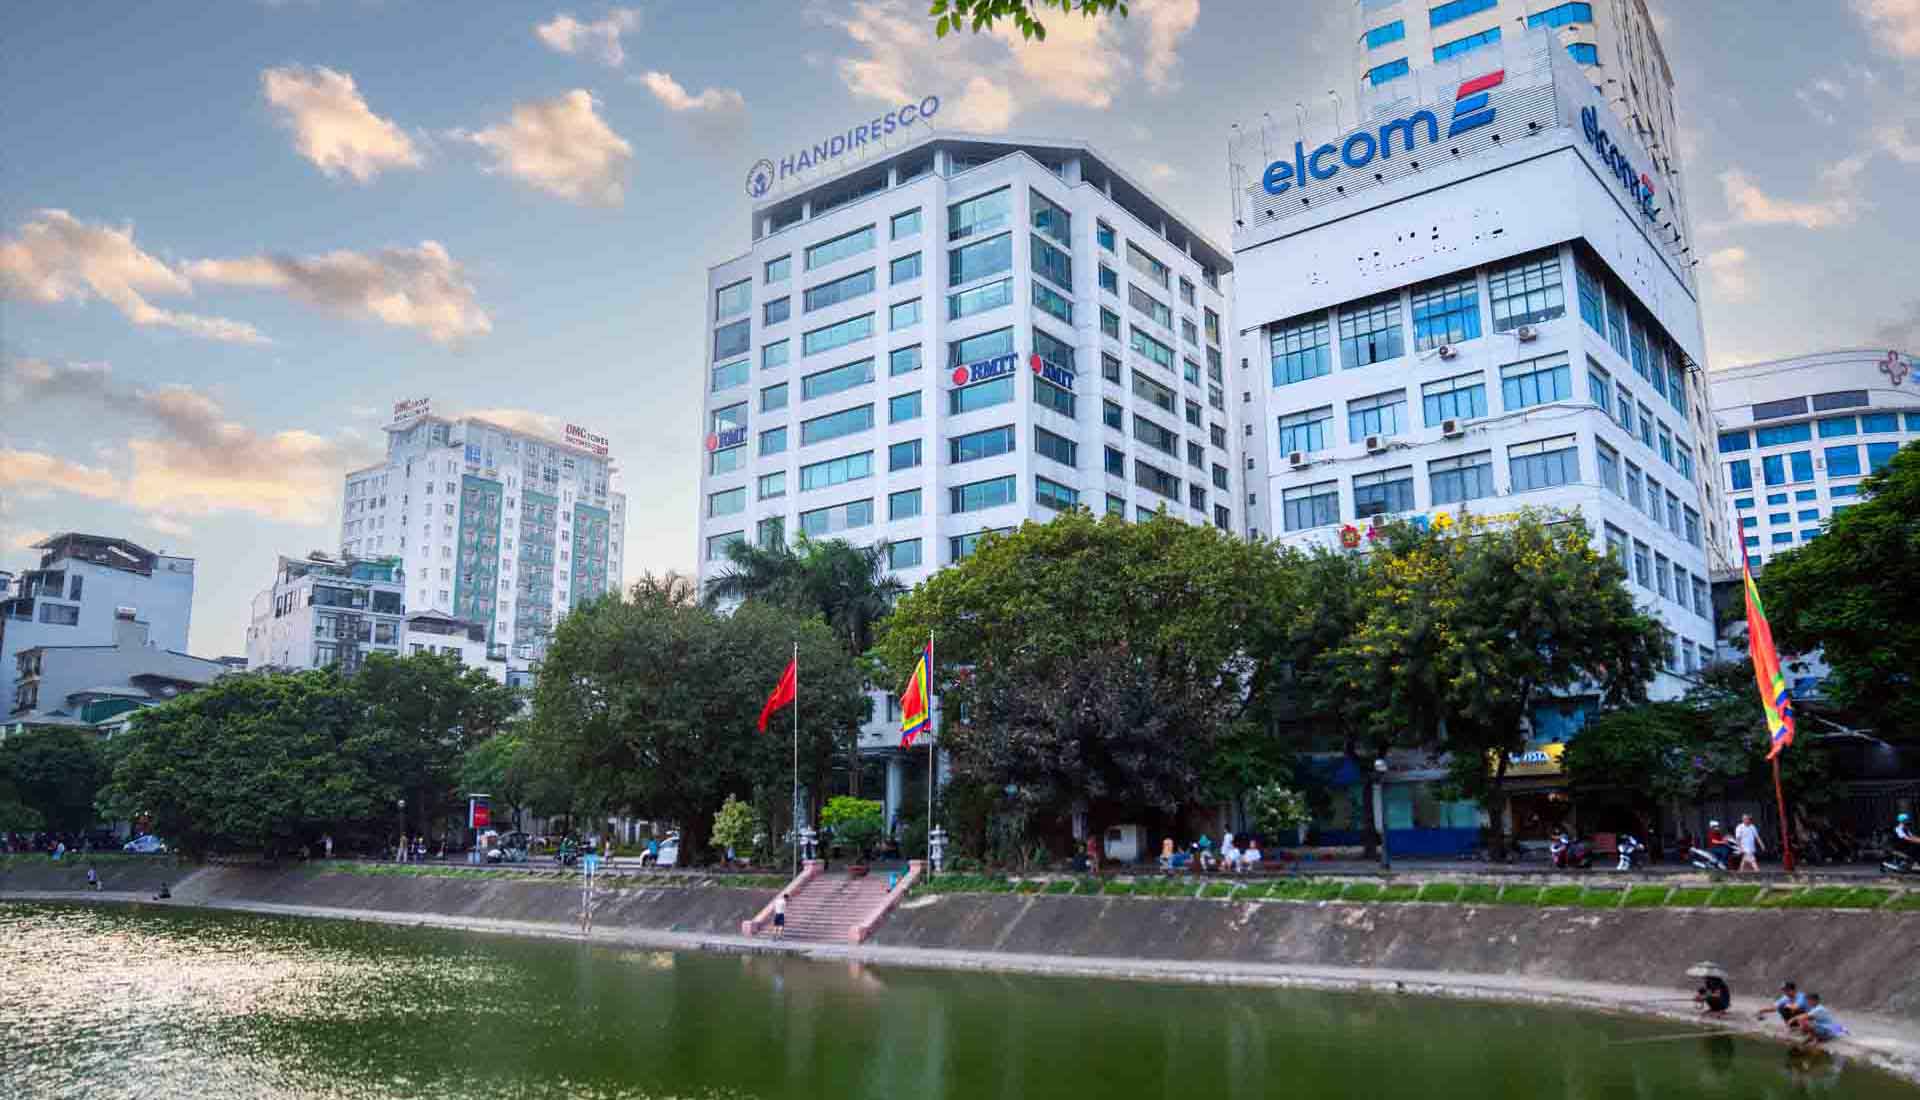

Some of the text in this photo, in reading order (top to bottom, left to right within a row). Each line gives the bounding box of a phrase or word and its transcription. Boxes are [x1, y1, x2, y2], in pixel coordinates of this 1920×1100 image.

[779, 96, 940, 180] HANDIRESCO
[1262, 110, 1439, 196] elcom
[969, 352, 1018, 382] RMIT
[1042, 359, 1074, 389] RMIT
